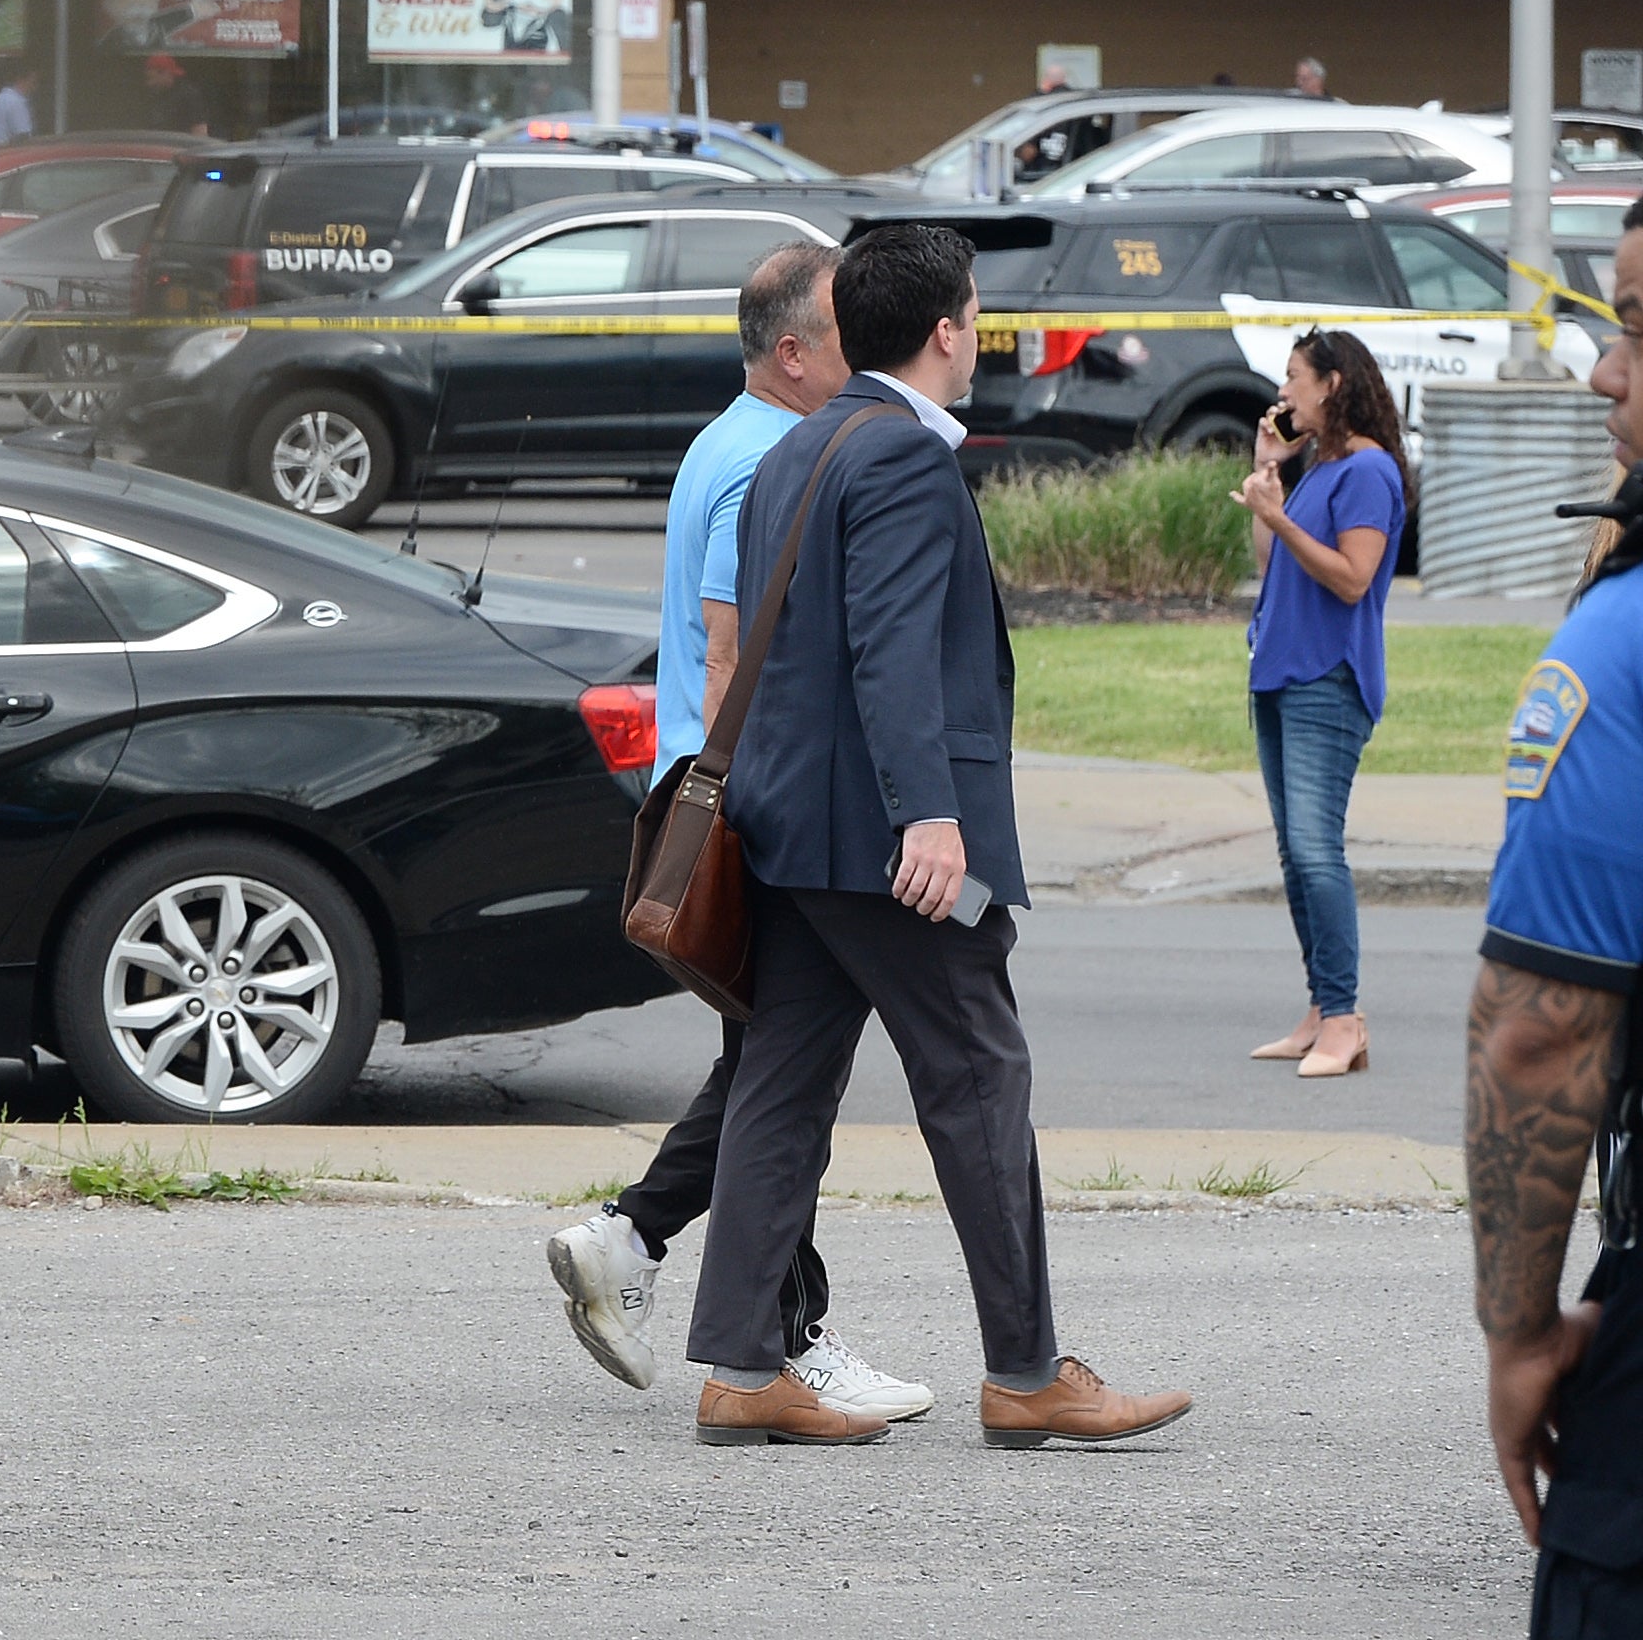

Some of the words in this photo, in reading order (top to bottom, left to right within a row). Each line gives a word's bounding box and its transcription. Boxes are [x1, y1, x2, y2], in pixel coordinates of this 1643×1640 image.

[325, 223, 367, 248] 579
[266, 248, 394, 274] BUFFALO
[1117, 251, 1163, 277] 245
